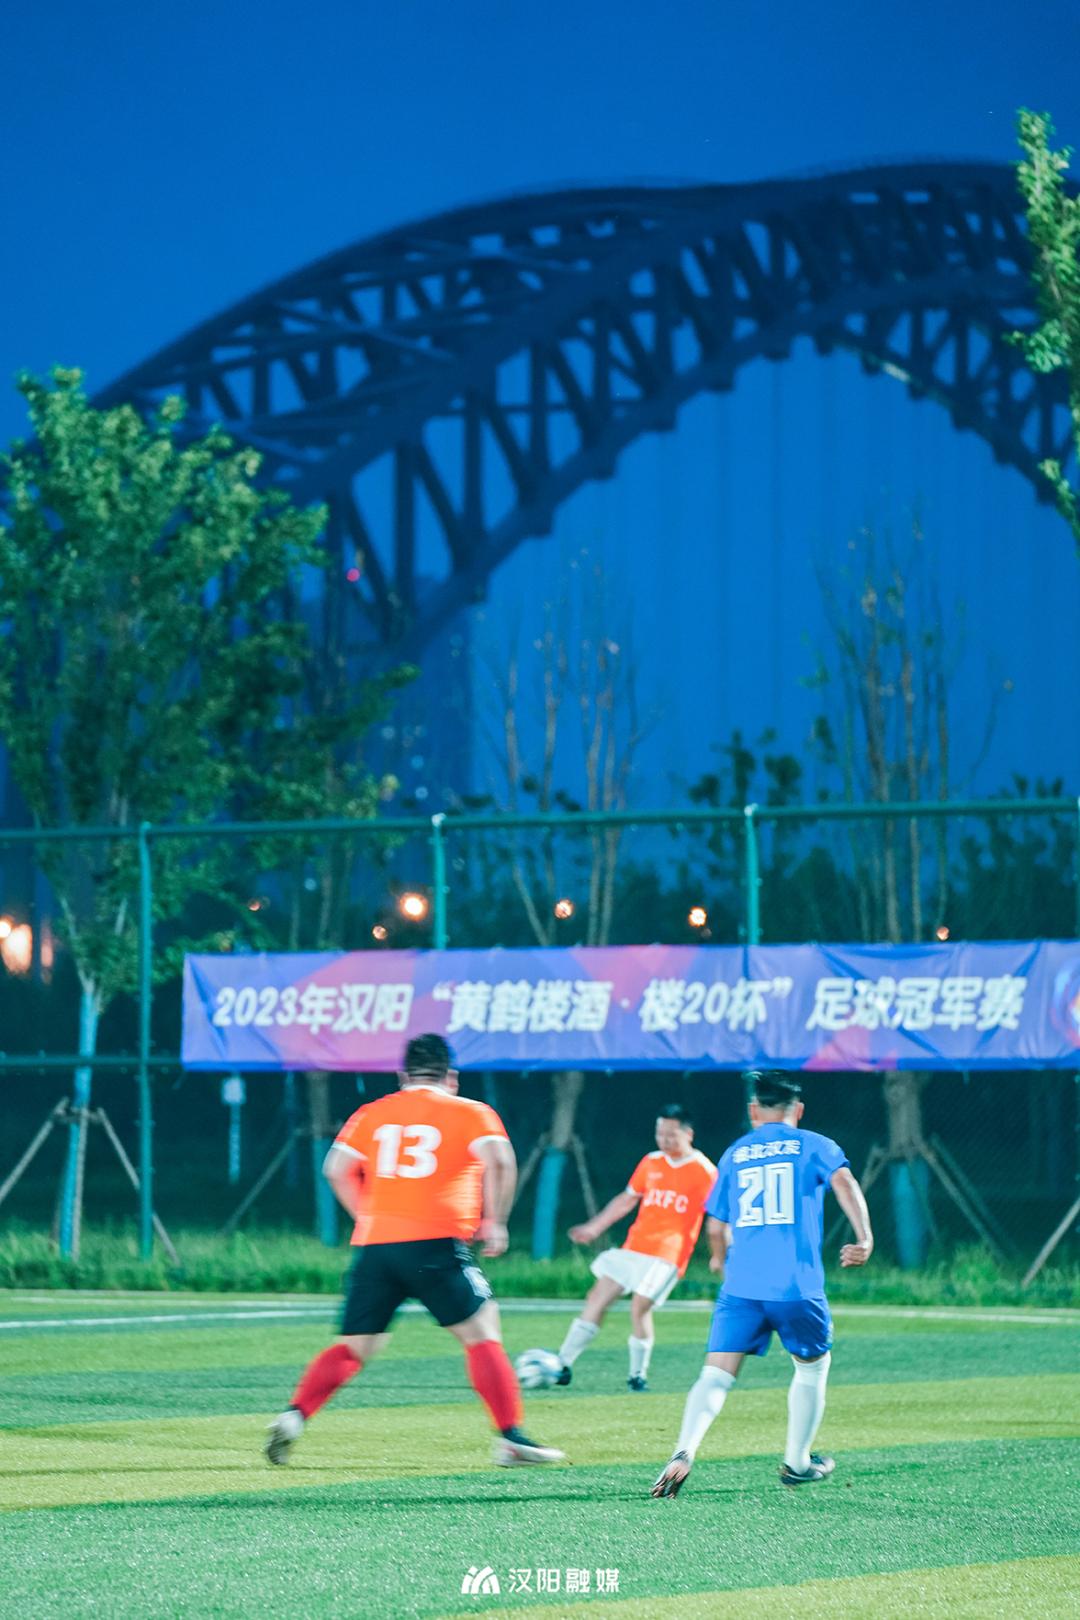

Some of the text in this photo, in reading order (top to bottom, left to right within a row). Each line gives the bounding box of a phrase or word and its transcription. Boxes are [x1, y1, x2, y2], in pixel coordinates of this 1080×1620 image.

[213, 983, 414, 1034] 2023年汉阳
[805, 974, 1027, 1032] 足球冠军赛
[372, 1124, 442, 1179] 13
[736, 1162, 795, 1228] 20
